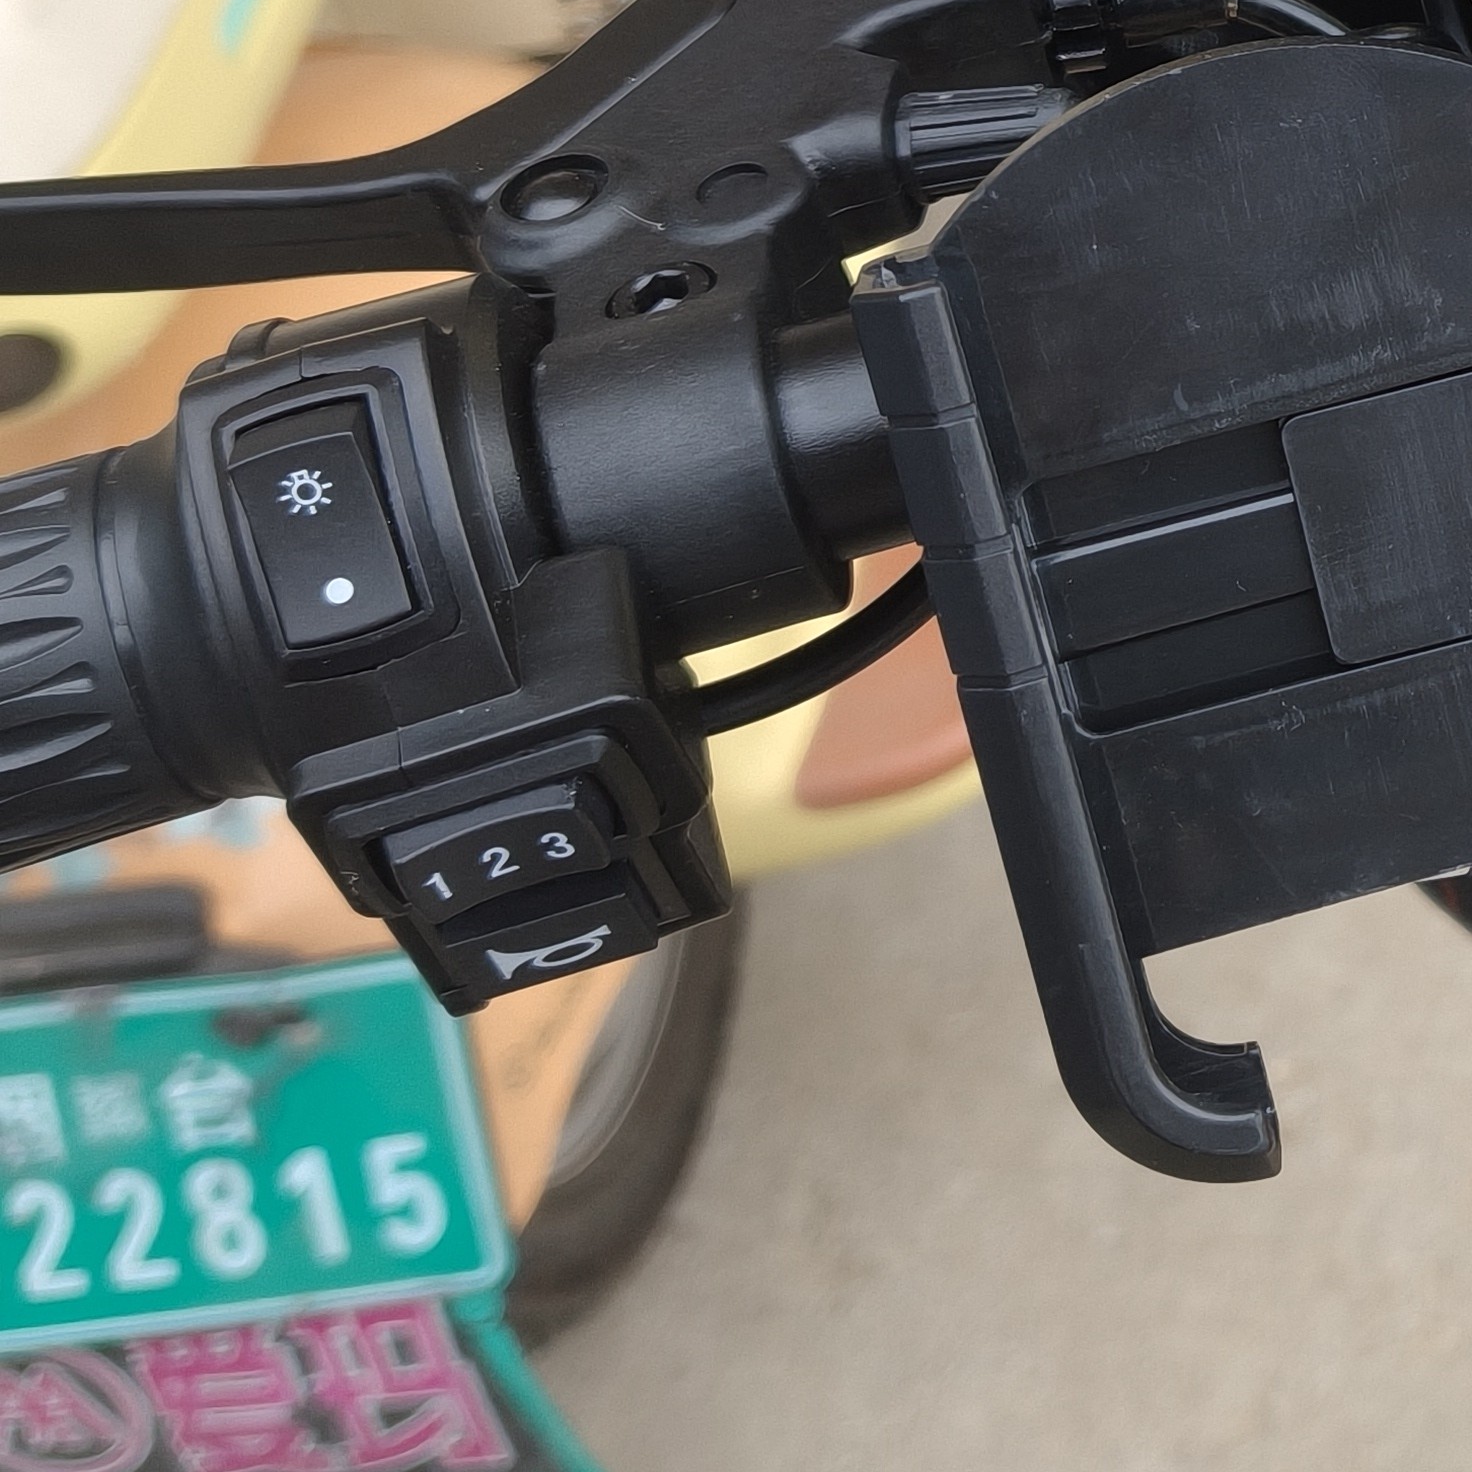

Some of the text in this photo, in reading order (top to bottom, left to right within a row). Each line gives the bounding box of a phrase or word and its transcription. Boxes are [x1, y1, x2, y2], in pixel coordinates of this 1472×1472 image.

[422, 832, 576, 900] 1 2 3
[4, 1133, 450, 1303] 22815
